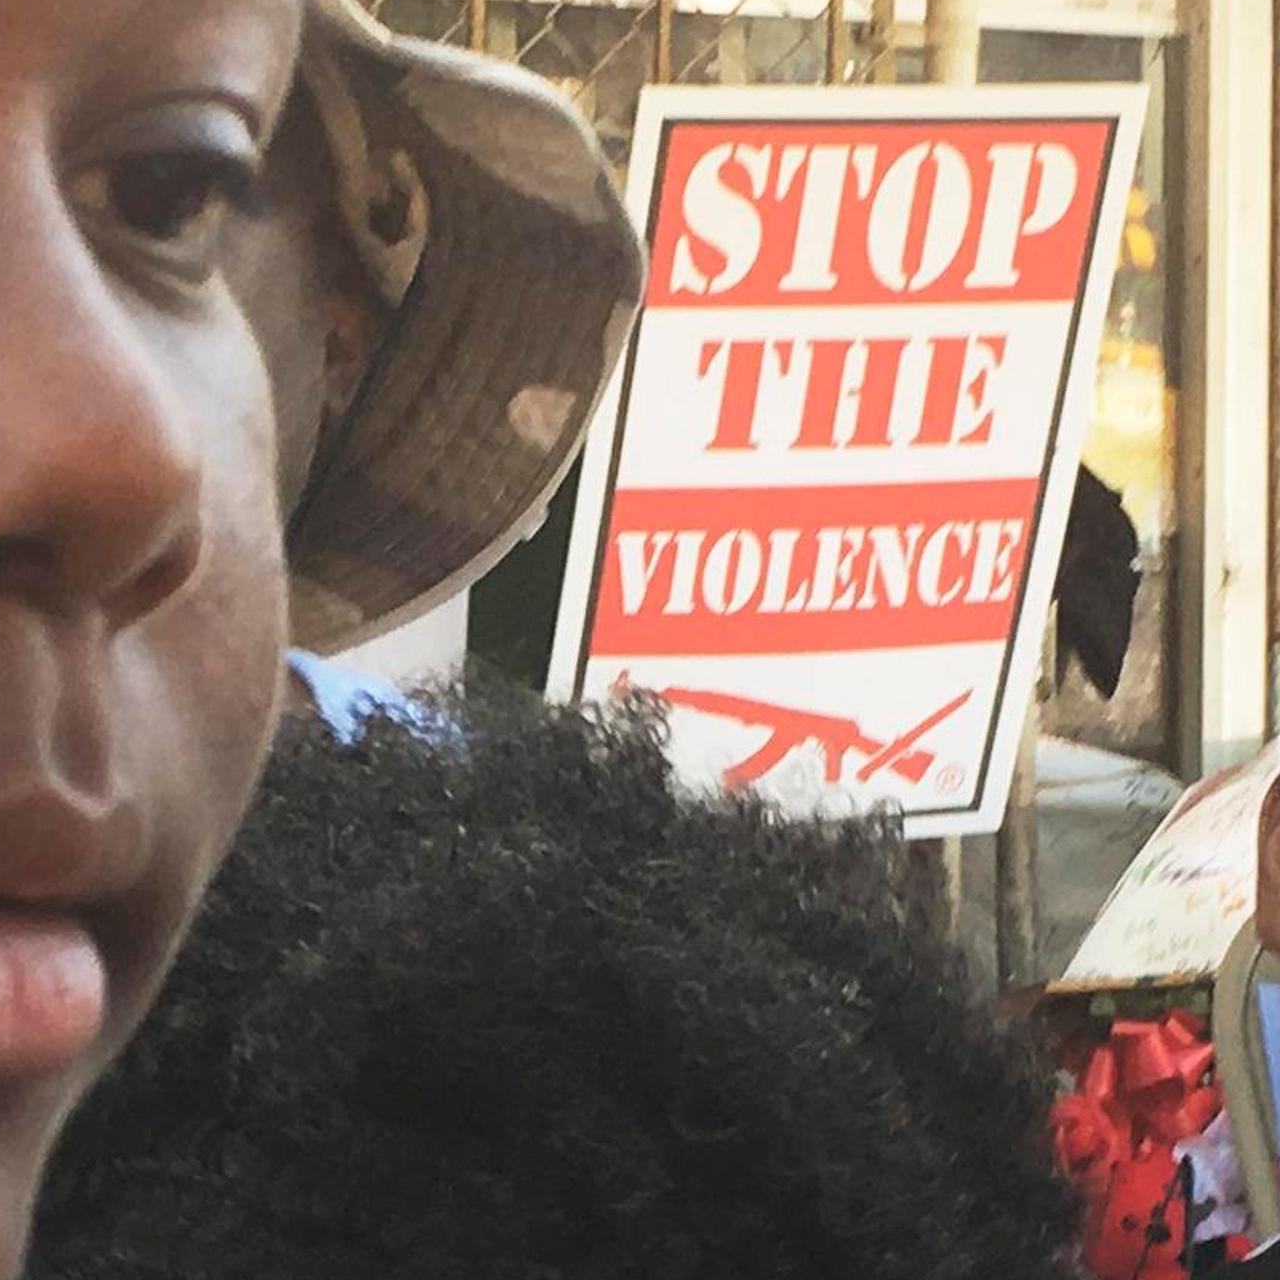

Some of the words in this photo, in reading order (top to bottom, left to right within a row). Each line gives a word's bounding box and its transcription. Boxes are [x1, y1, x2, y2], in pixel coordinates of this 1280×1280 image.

[670, 142, 1079, 296] STOP
[697, 334, 1008, 452] THE
[615, 519, 1024, 616] VIOLENCE
